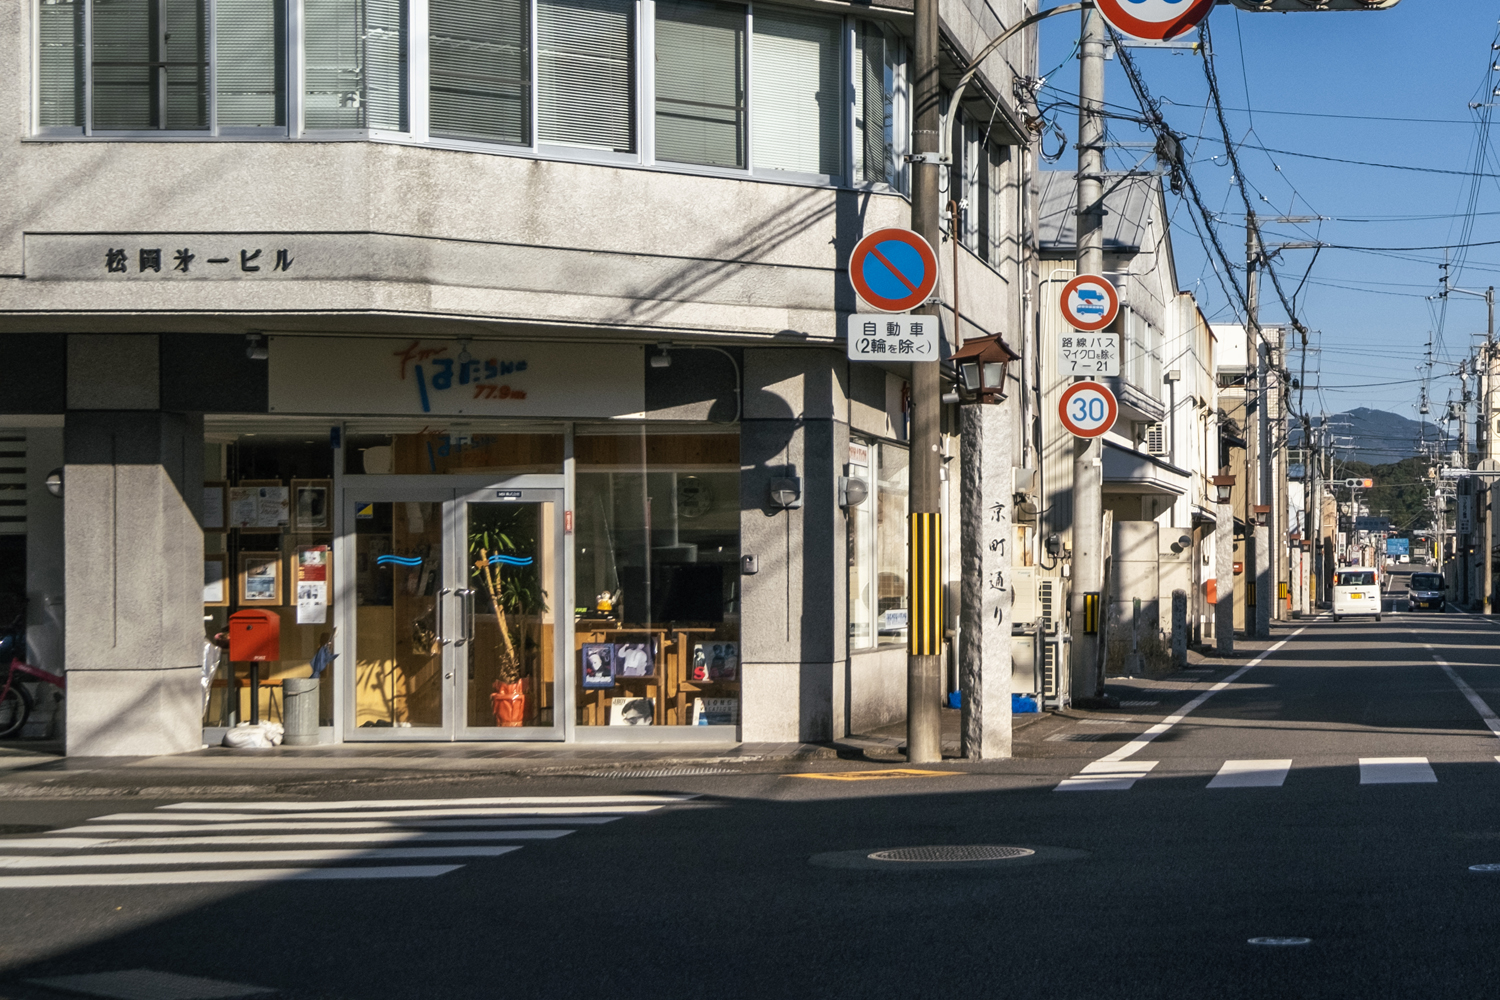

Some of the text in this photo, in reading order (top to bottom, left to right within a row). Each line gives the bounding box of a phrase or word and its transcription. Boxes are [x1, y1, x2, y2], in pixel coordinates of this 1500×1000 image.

[862, 321, 925, 337] 自動車
[855, 338, 932, 355] (2輪を除く)
[1061, 337, 1116, 348] 路線バス
[1062, 349, 1115, 360] マイクロを除く
[1072, 397, 1105, 422] 30
[988, 501, 1007, 627] 京町通り
